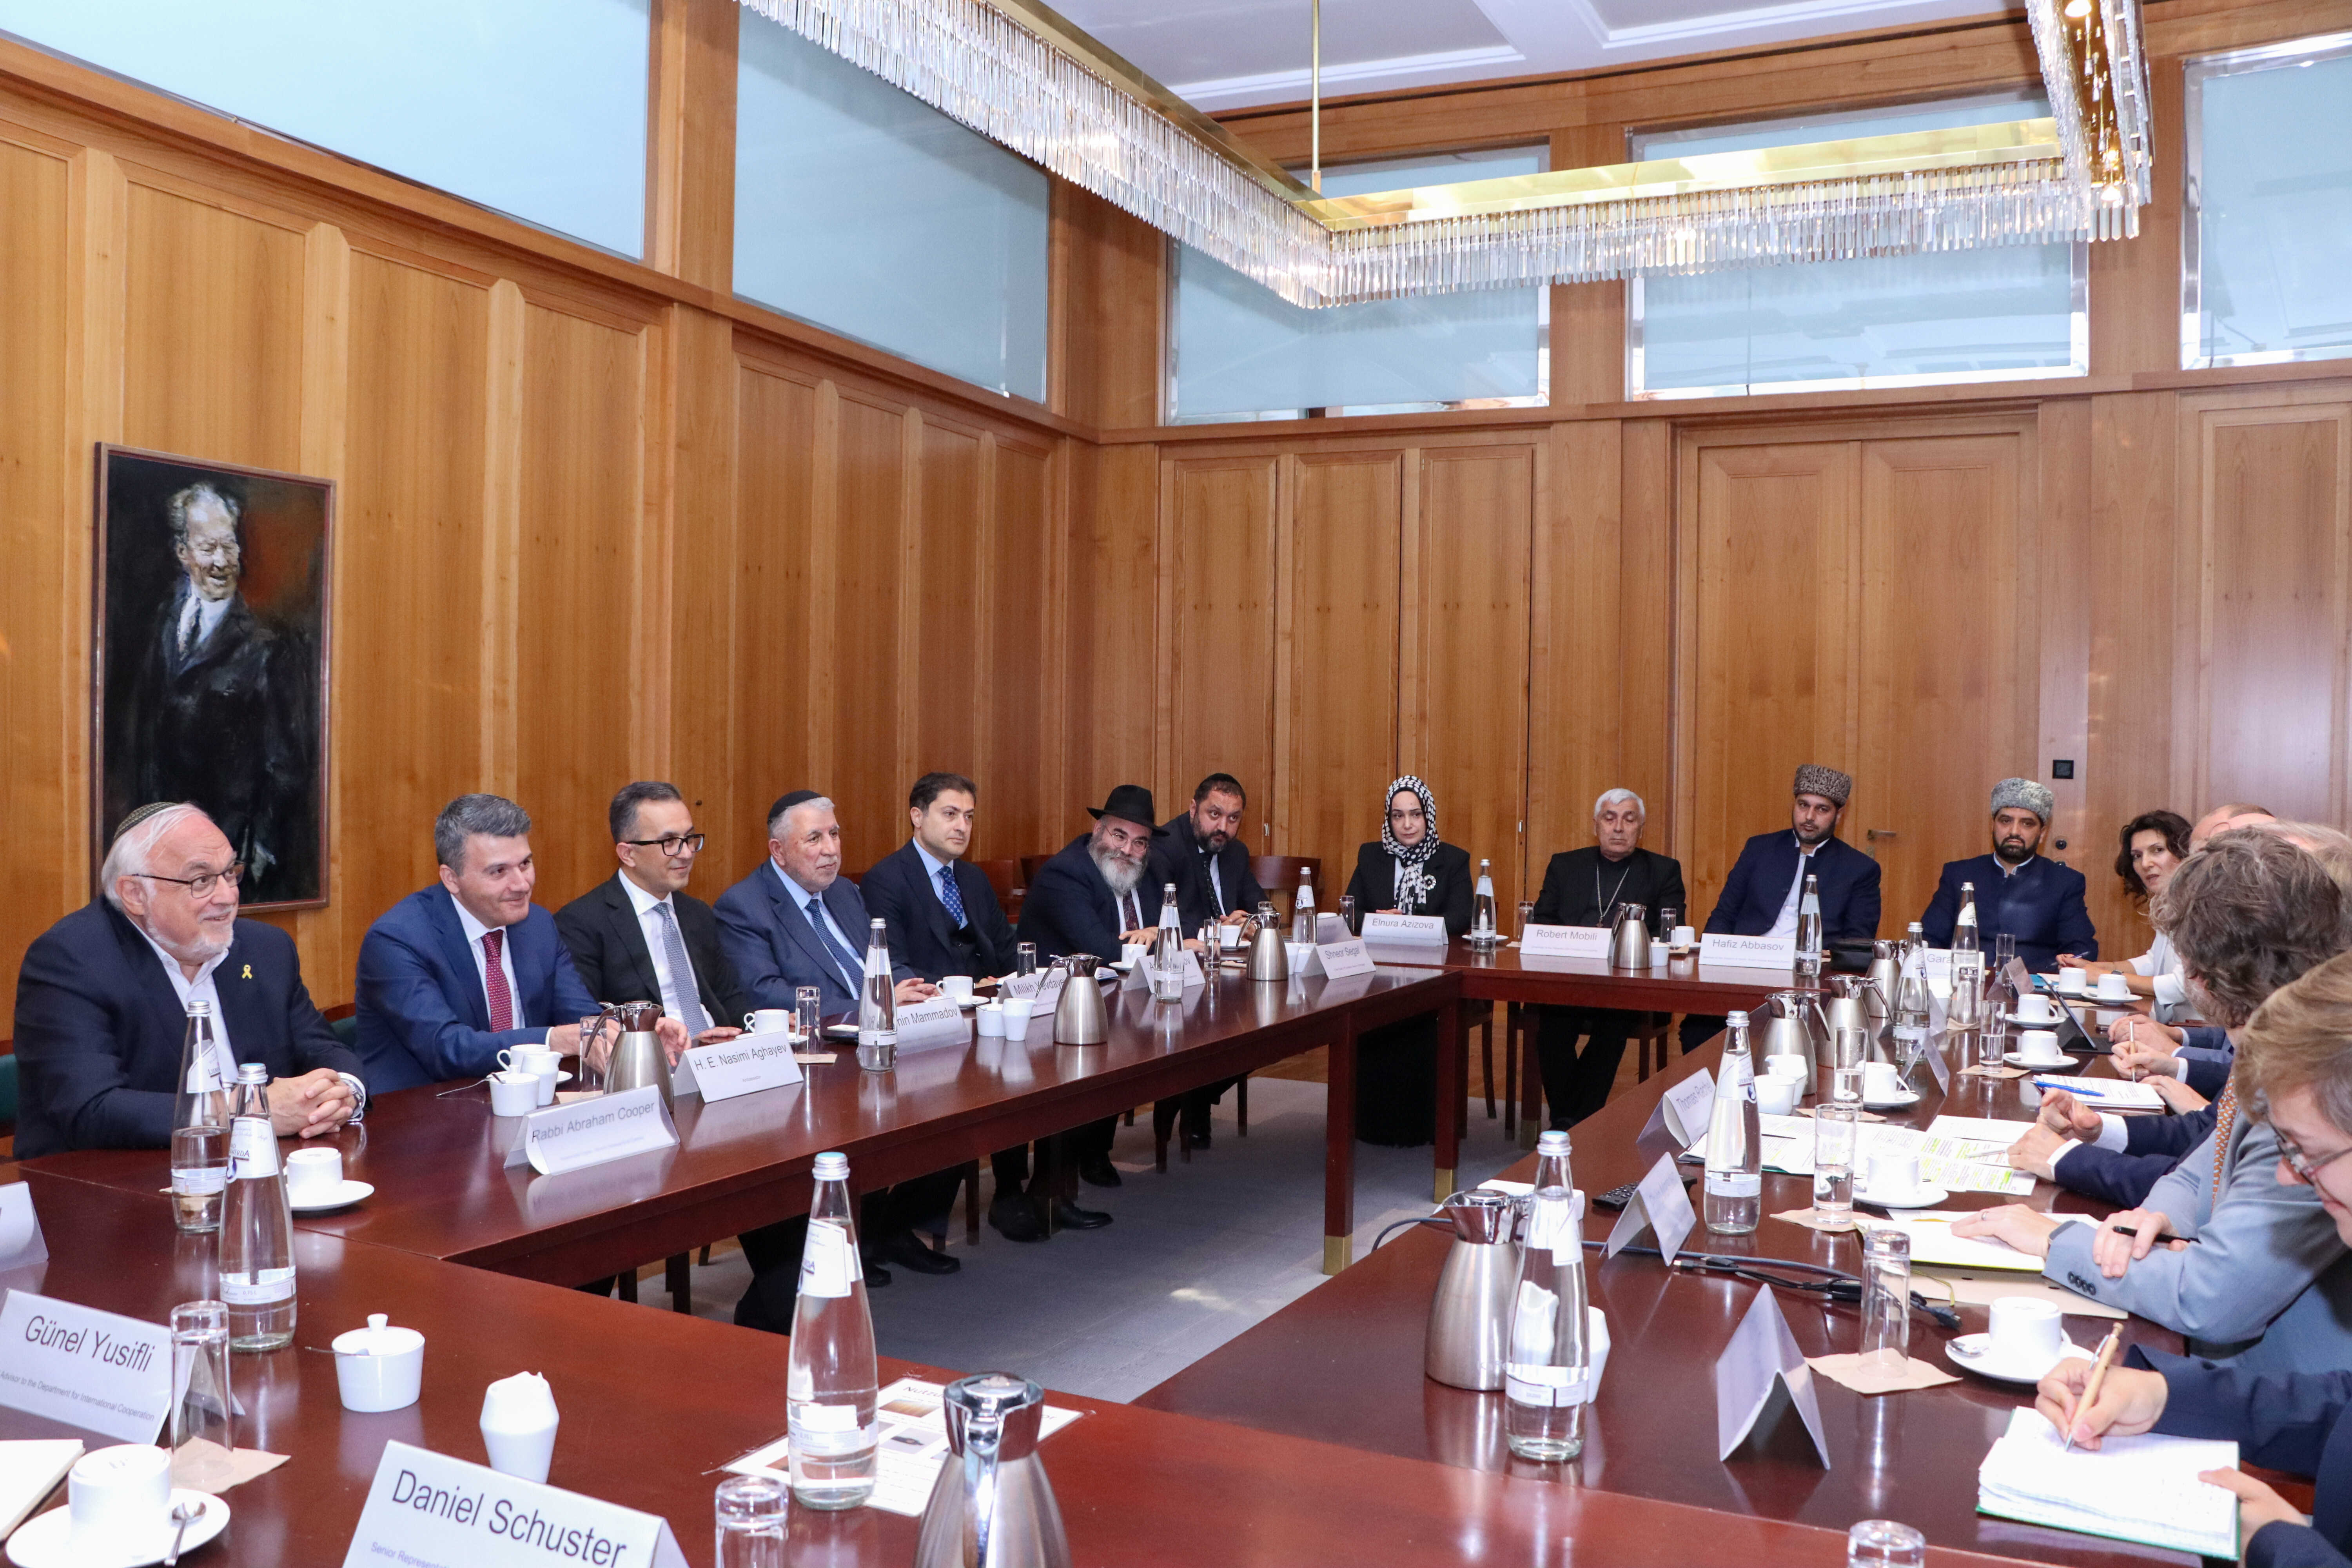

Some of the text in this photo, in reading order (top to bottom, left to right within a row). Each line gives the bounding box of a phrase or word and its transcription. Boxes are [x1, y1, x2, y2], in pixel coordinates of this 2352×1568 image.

[1372, 918, 1434, 929] Elnura Azizova
[1536, 929, 1598, 940] Robert Mobili
[1325, 945, 1361, 960] Shneor Segal
[1712, 939, 1784, 951] Hafiz Abbasov
[1013, 978, 1065, 995] Milikh Yevdaye
[911, 1007, 958, 1024] Mammadov
[694, 1044, 787, 1071] H. E. Nasimi Aghayev
[532, 1102, 655, 1143] Rabbi Abraham Cooper
[25, 1315, 155, 1372] Günel Yusifli
[37, 1380, 71, 1398] Department
[71, 1390, 80, 1400] for
[80, 1392, 118, 1410] International
[118, 1403, 154, 1421] Cooperation
[392, 1469, 627, 1568] Daniel Schuster
[371, 1541, 397, 1558] Senior
